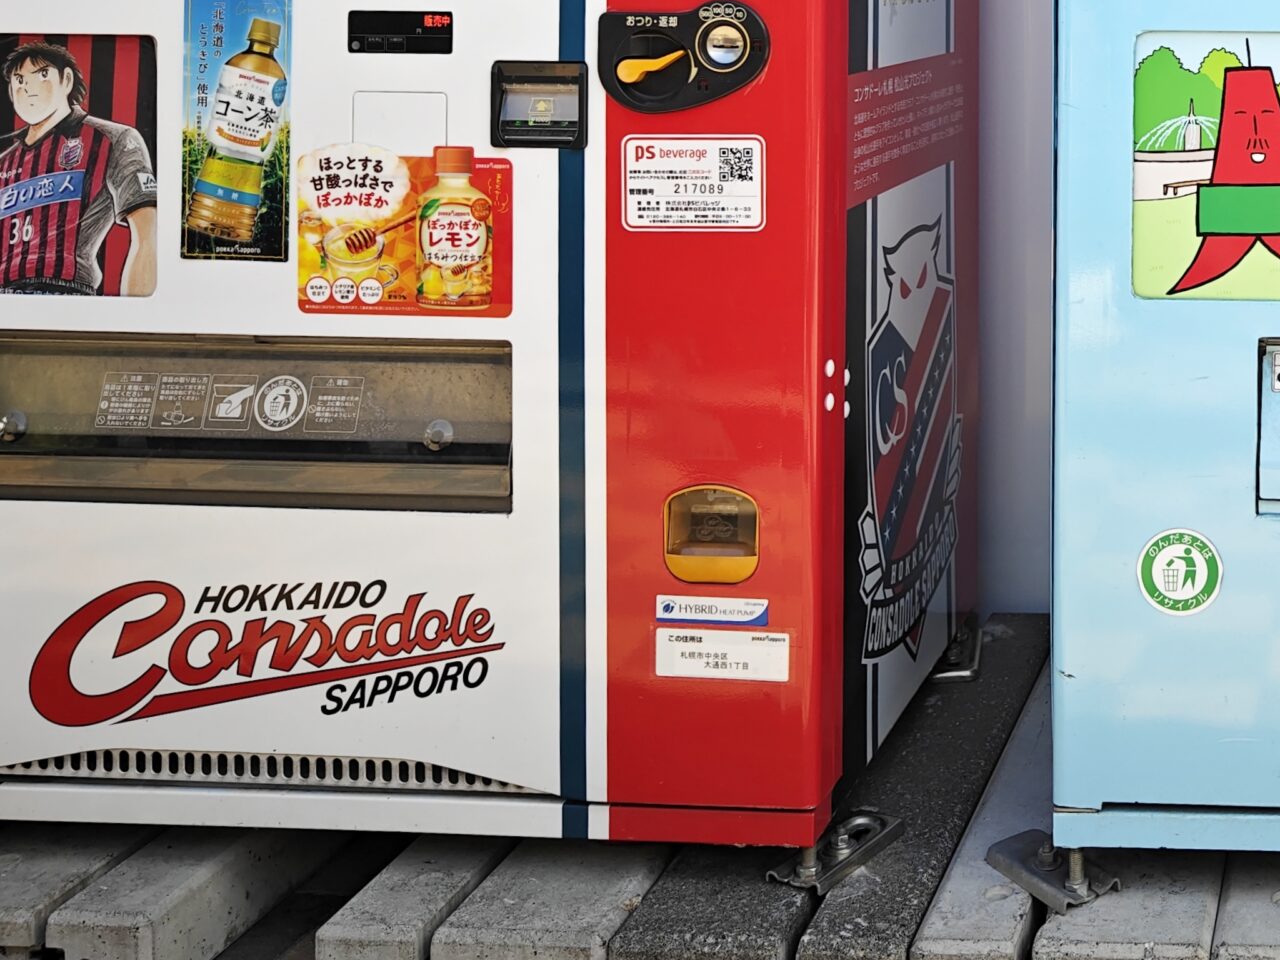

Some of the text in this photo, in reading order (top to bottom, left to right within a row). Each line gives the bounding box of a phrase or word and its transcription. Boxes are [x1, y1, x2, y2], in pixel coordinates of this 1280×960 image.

[423, 15, 451, 27] 販売中
[626, 16, 678, 27] おつり・返却
[216, 99, 277, 129] コーン茶
[659, 148, 708, 161] beverage
[319, 156, 383, 173] ほっとする
[310, 174, 394, 192] 甘酸っぱさで
[674, 183, 724, 194] 217089
[1, 175, 74, 210] 白い恋人
[317, 192, 389, 209] ぽっかぽか
[9, 215, 34, 245] 36
[428, 231, 480, 248] レモン
[1148, 533, 1213, 560] のんだあとは
[194, 579, 388, 614] HOKKAIDO
[1152, 591, 1208, 610] リサイクル
[679, 604, 718, 615] HYBRID
[668, 635, 703, 643] この住所は
[28, 580, 495, 727] Consadole
[680, 651, 728, 660] 札幌市中央区
[704, 661, 749, 670] 大通西1丁目
[320, 657, 489, 715] SAPPORO
